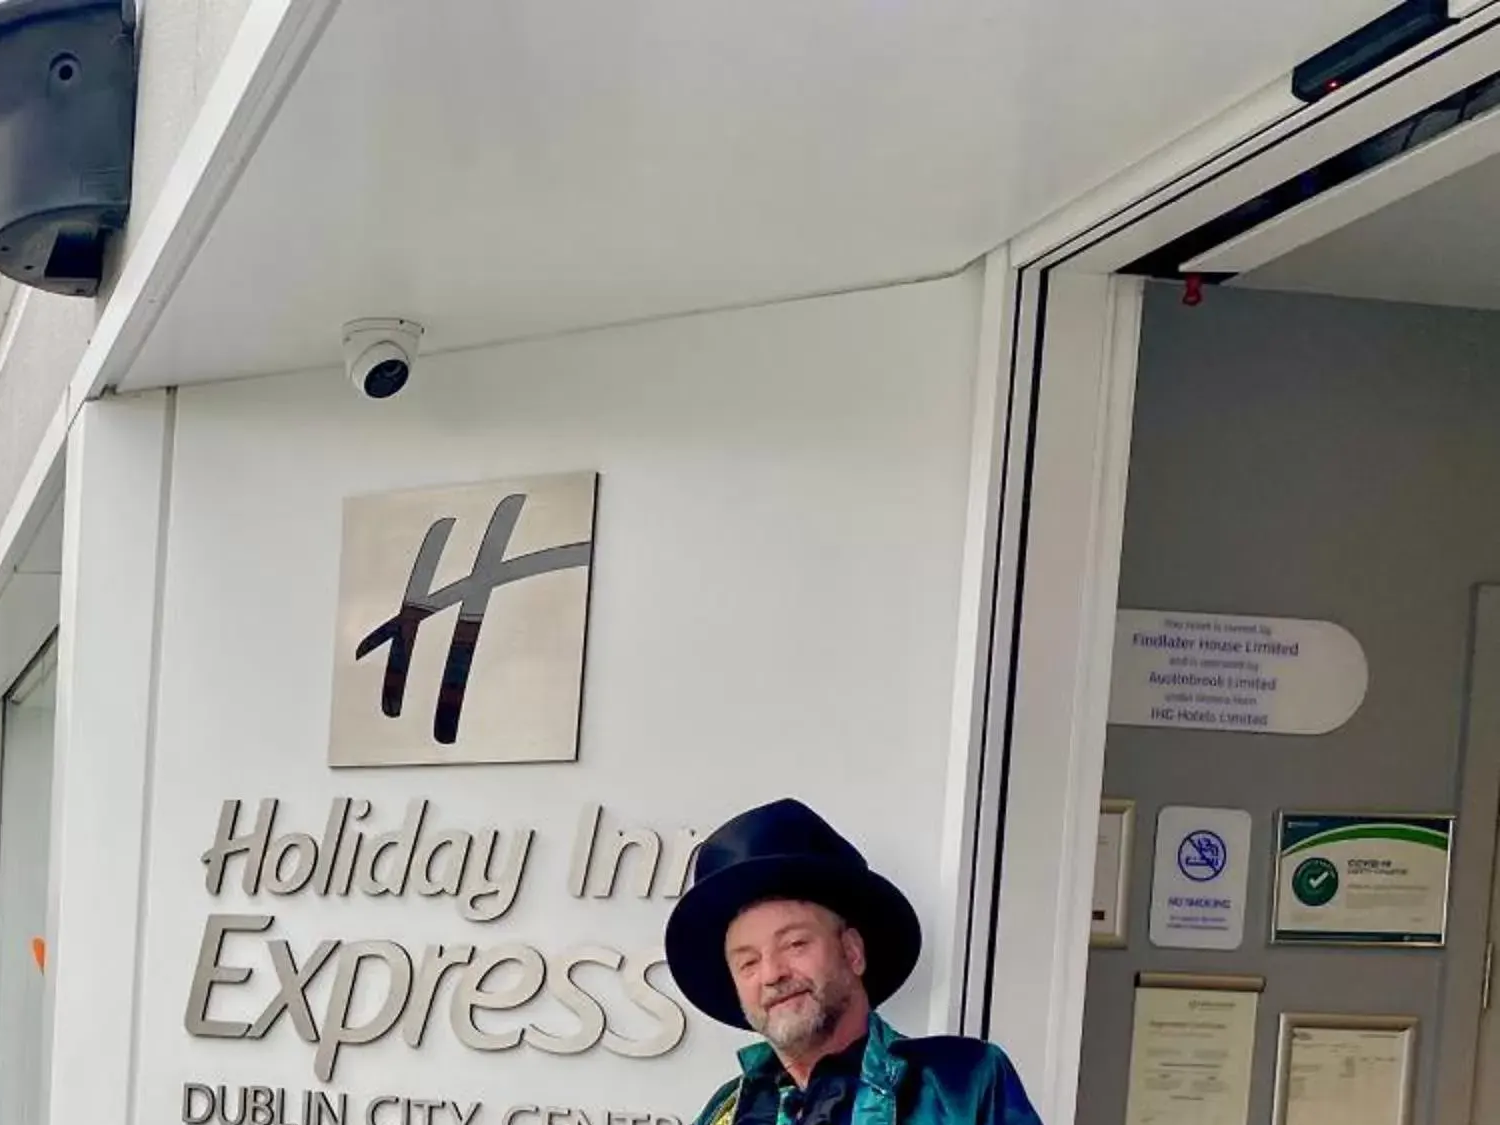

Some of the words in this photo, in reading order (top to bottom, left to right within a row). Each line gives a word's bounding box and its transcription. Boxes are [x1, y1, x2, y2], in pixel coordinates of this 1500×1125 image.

[1132, 633, 1195, 650] Findlater
[1245, 640, 1299, 656] Limited
[1227, 676, 1276, 692] Limited
[1177, 708, 1217, 723] Hotels
[1219, 710, 1268, 726] Limited
[201, 797, 536, 922] Holiday
[183, 913, 687, 1083] Express
